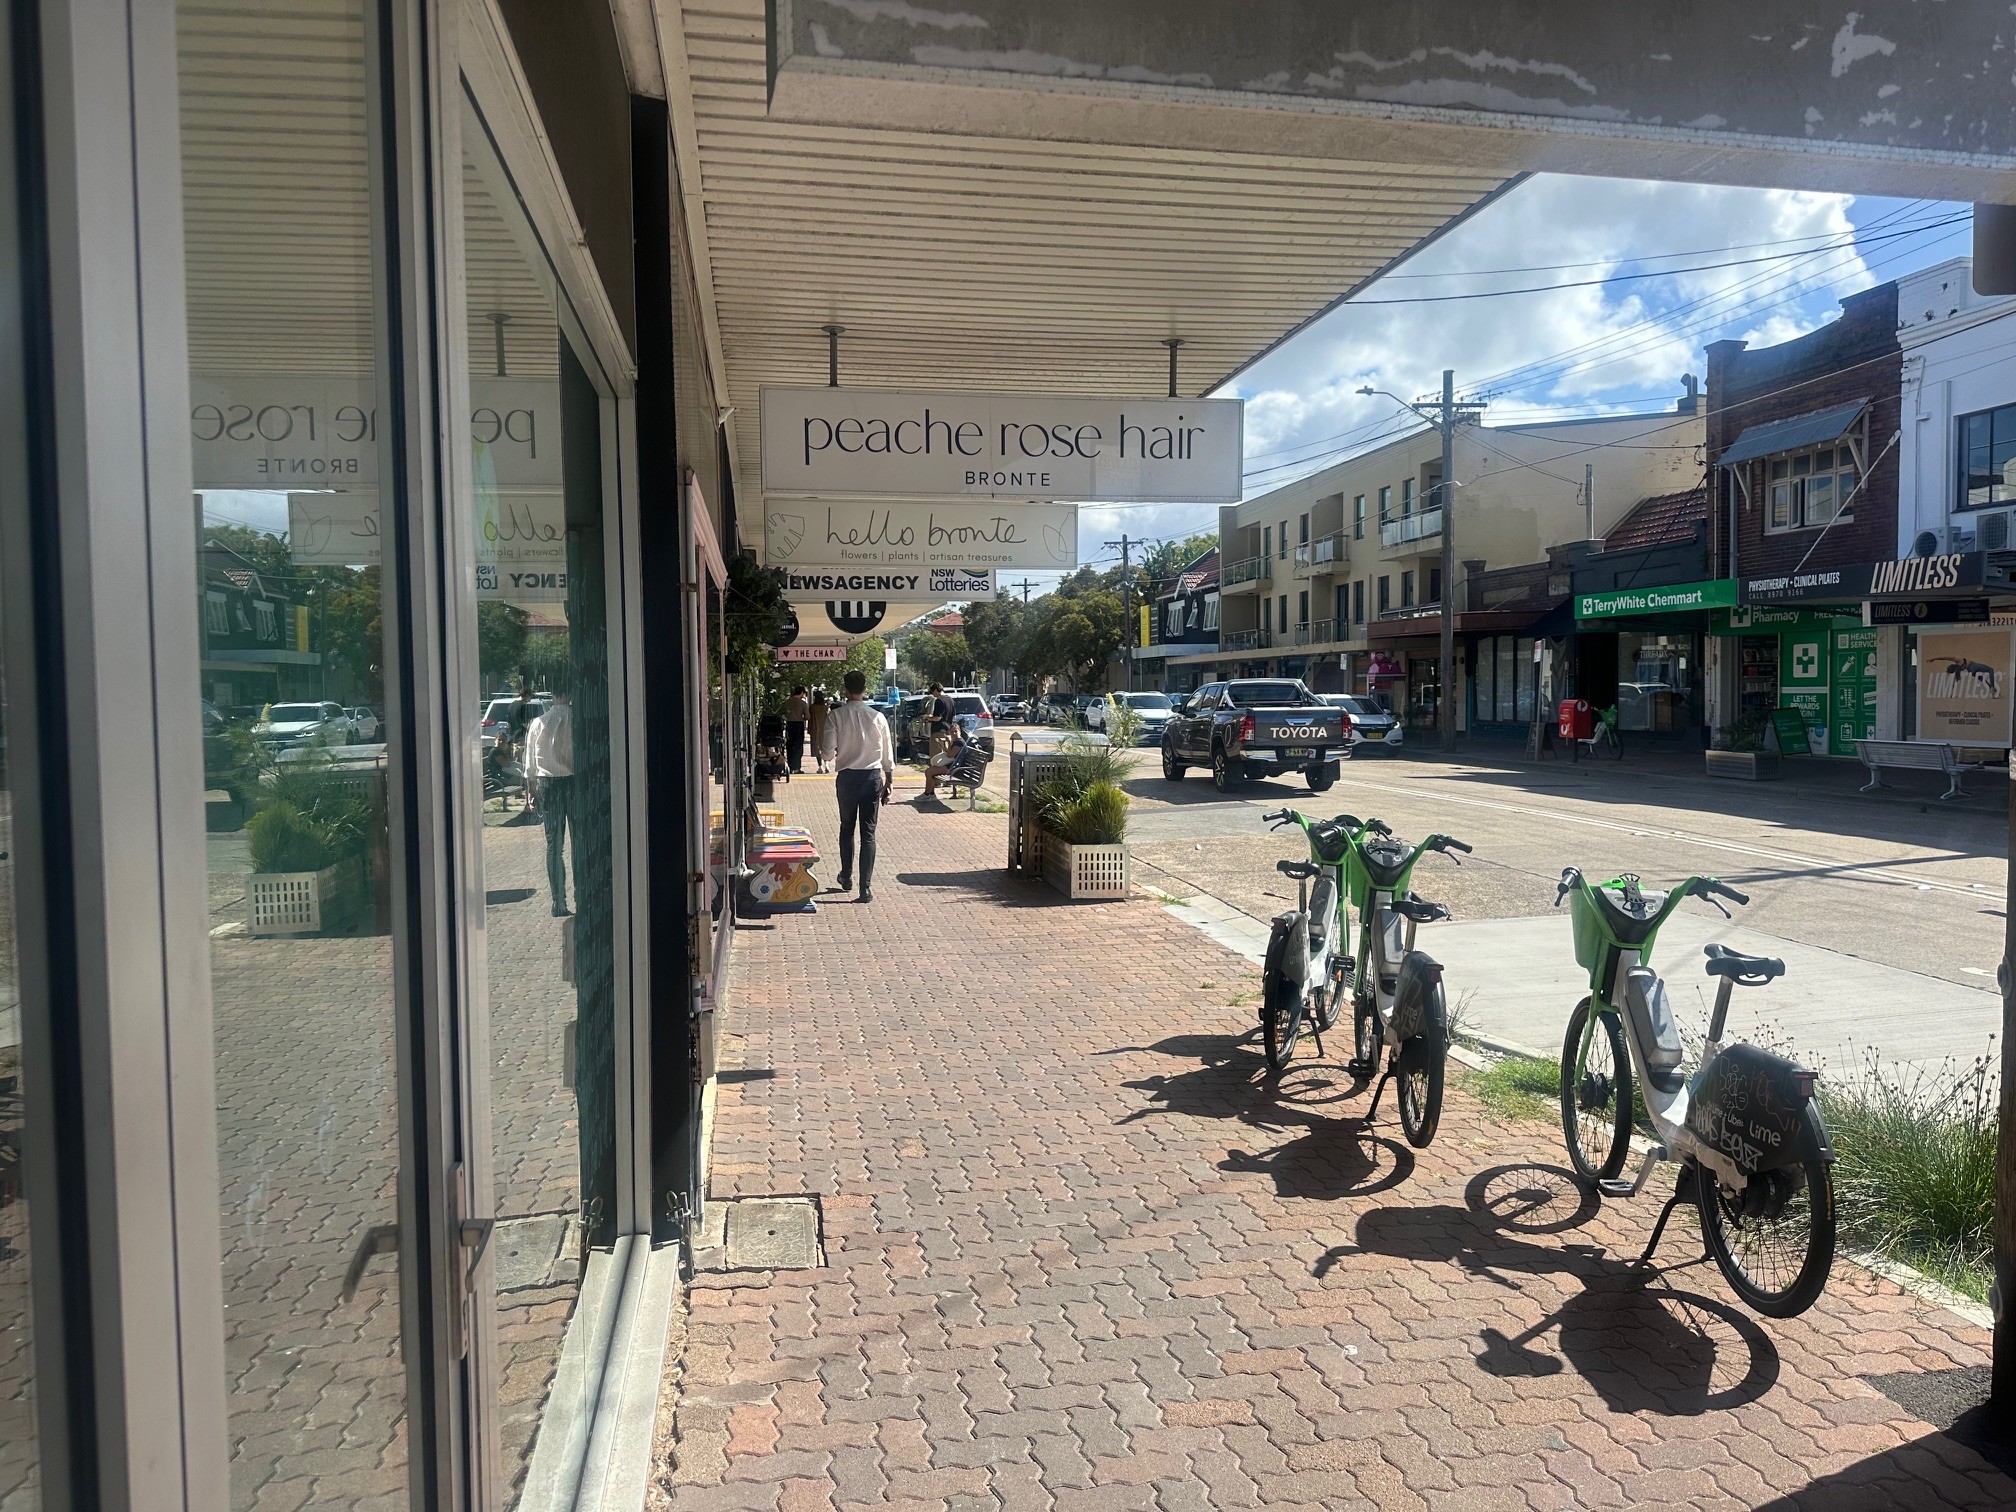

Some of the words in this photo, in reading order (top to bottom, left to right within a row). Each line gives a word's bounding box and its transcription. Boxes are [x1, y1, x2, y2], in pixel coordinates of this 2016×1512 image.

[804, 409, 983, 465] peache
[1000, 421, 1103, 458] rose
[1120, 414, 1206, 460] hair
[965, 471, 1050, 487] BRONTE
[827, 507, 914, 546] hello
[928, 513, 1027, 547] bronte
[840, 549, 878, 560] flowers
[888, 551, 919, 561] plants
[929, 552, 964, 561] artisan
[967, 553, 1013, 562] treasures
[931, 568, 955, 577] NSW
[1869, 553, 1961, 594] LIMITLESS
[929, 577, 990, 592] Lotteries
[1748, 577, 1790, 593] PHYSIOTHERAPY
[1793, 574, 1818, 587] CLINICAL
[1818, 571, 1840, 585] PILATES
[1593, 596, 1646, 614] TerryWhite
[1647, 589, 1703, 608] Chemmart
[1752, 611, 1800, 624] Pharmacy
[1850, 632, 1877, 641] HEALTH
[795, 649, 811, 658] THE
[814, 649, 835, 658] CHAR
[1793, 695, 1804, 703] LET
[1805, 695, 1817, 703] THE
[1270, 726, 1328, 738] TOYOTA
